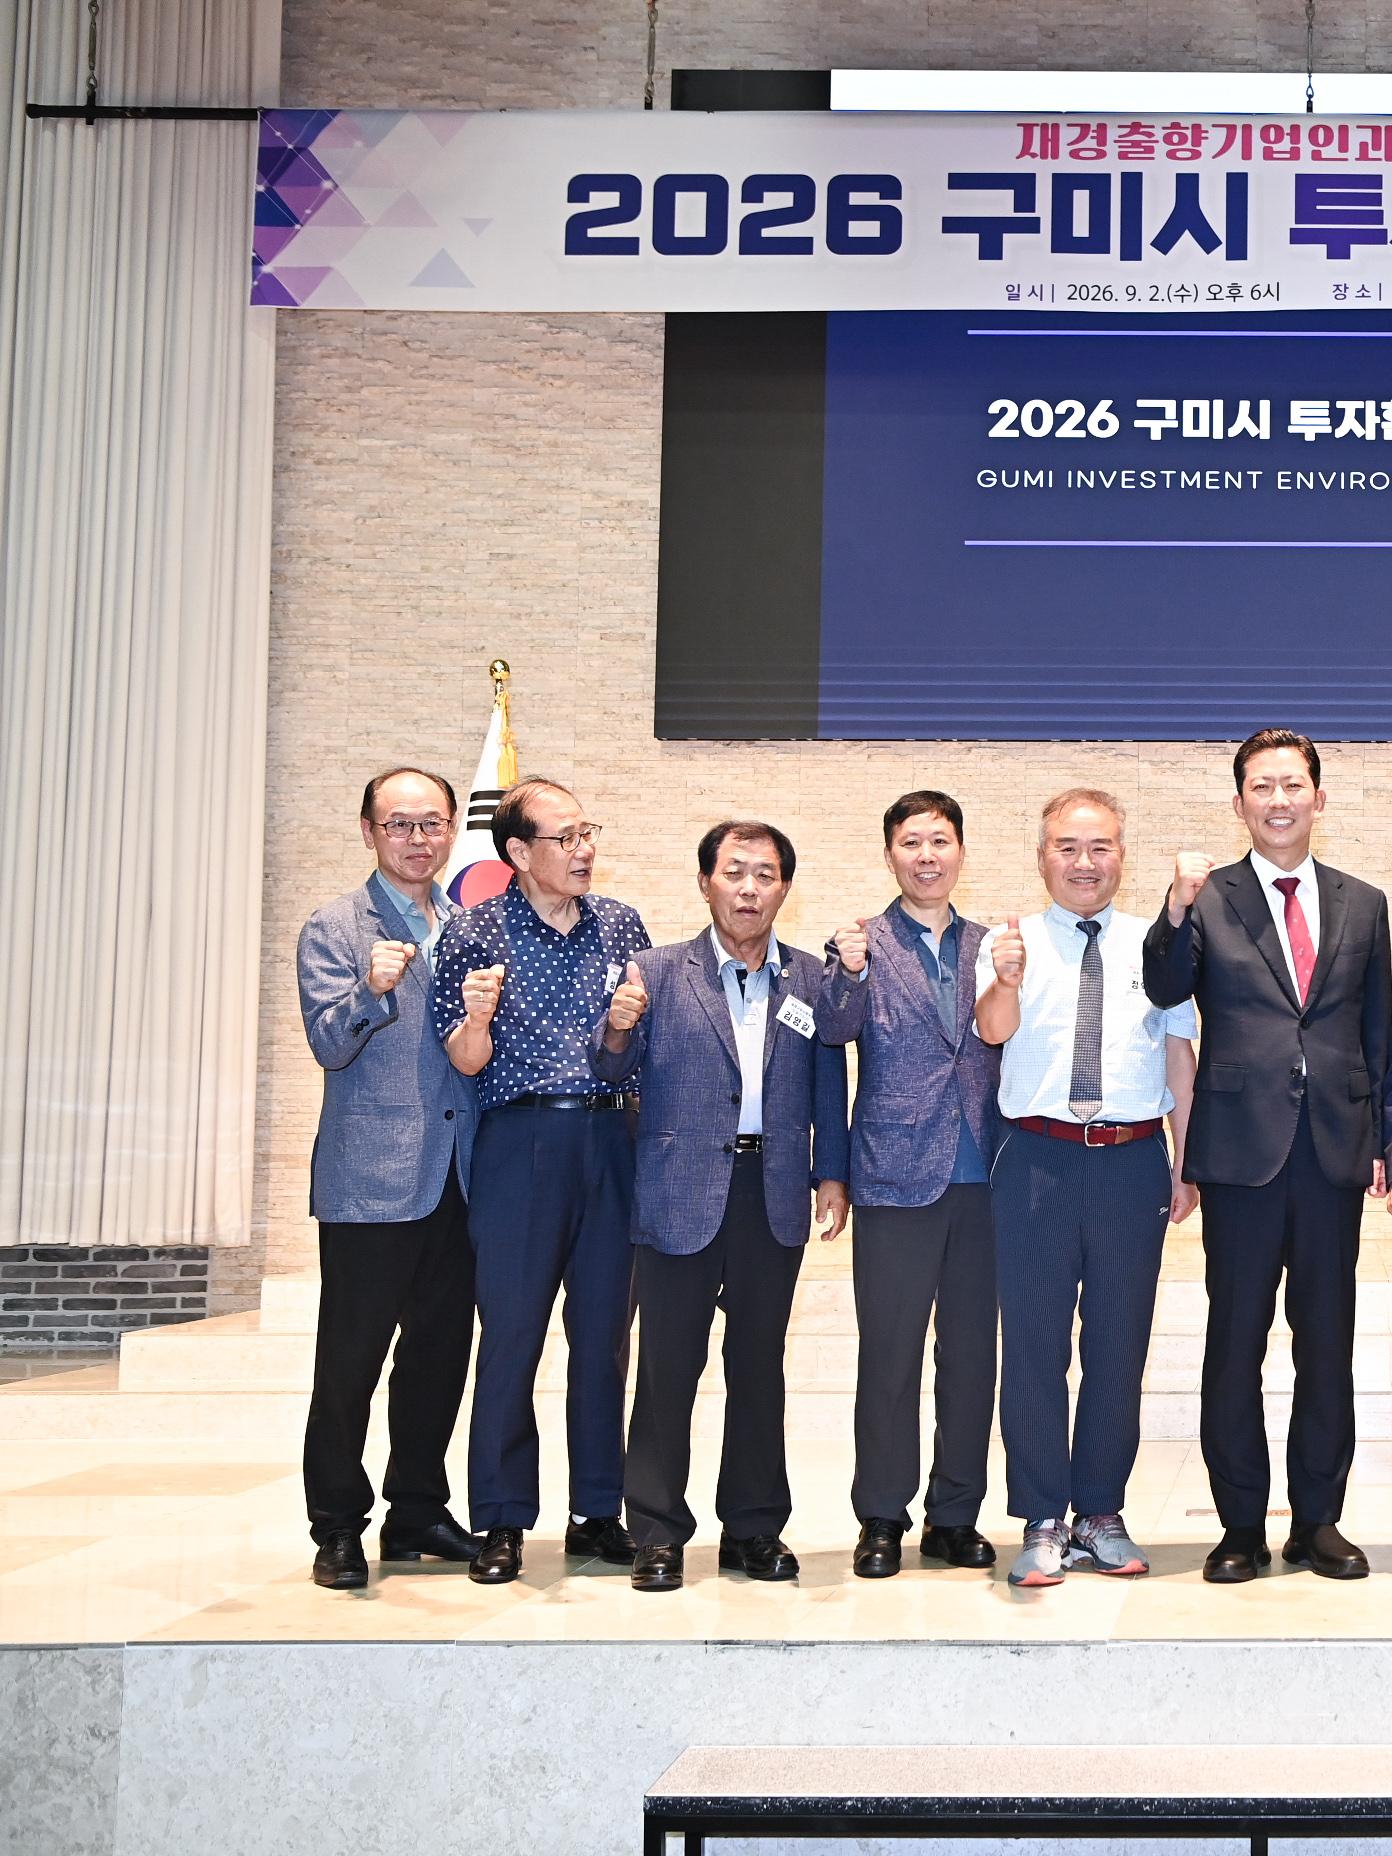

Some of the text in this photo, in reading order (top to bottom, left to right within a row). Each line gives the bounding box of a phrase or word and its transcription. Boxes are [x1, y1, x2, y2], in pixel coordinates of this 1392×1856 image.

[564, 173, 903, 256] 2026
[941, 171, 1249, 262] 구미시
[1066, 283, 1119, 302] 2026.
[1205, 282, 1245, 303] 오후
[1250, 281, 1280, 302] 6시
[987, 398, 1120, 439] 2026
[1133, 399, 1271, 441] 구미시
[976, 469, 1053, 488] GUMI
[1067, 470, 1263, 490] INVESTMENT
